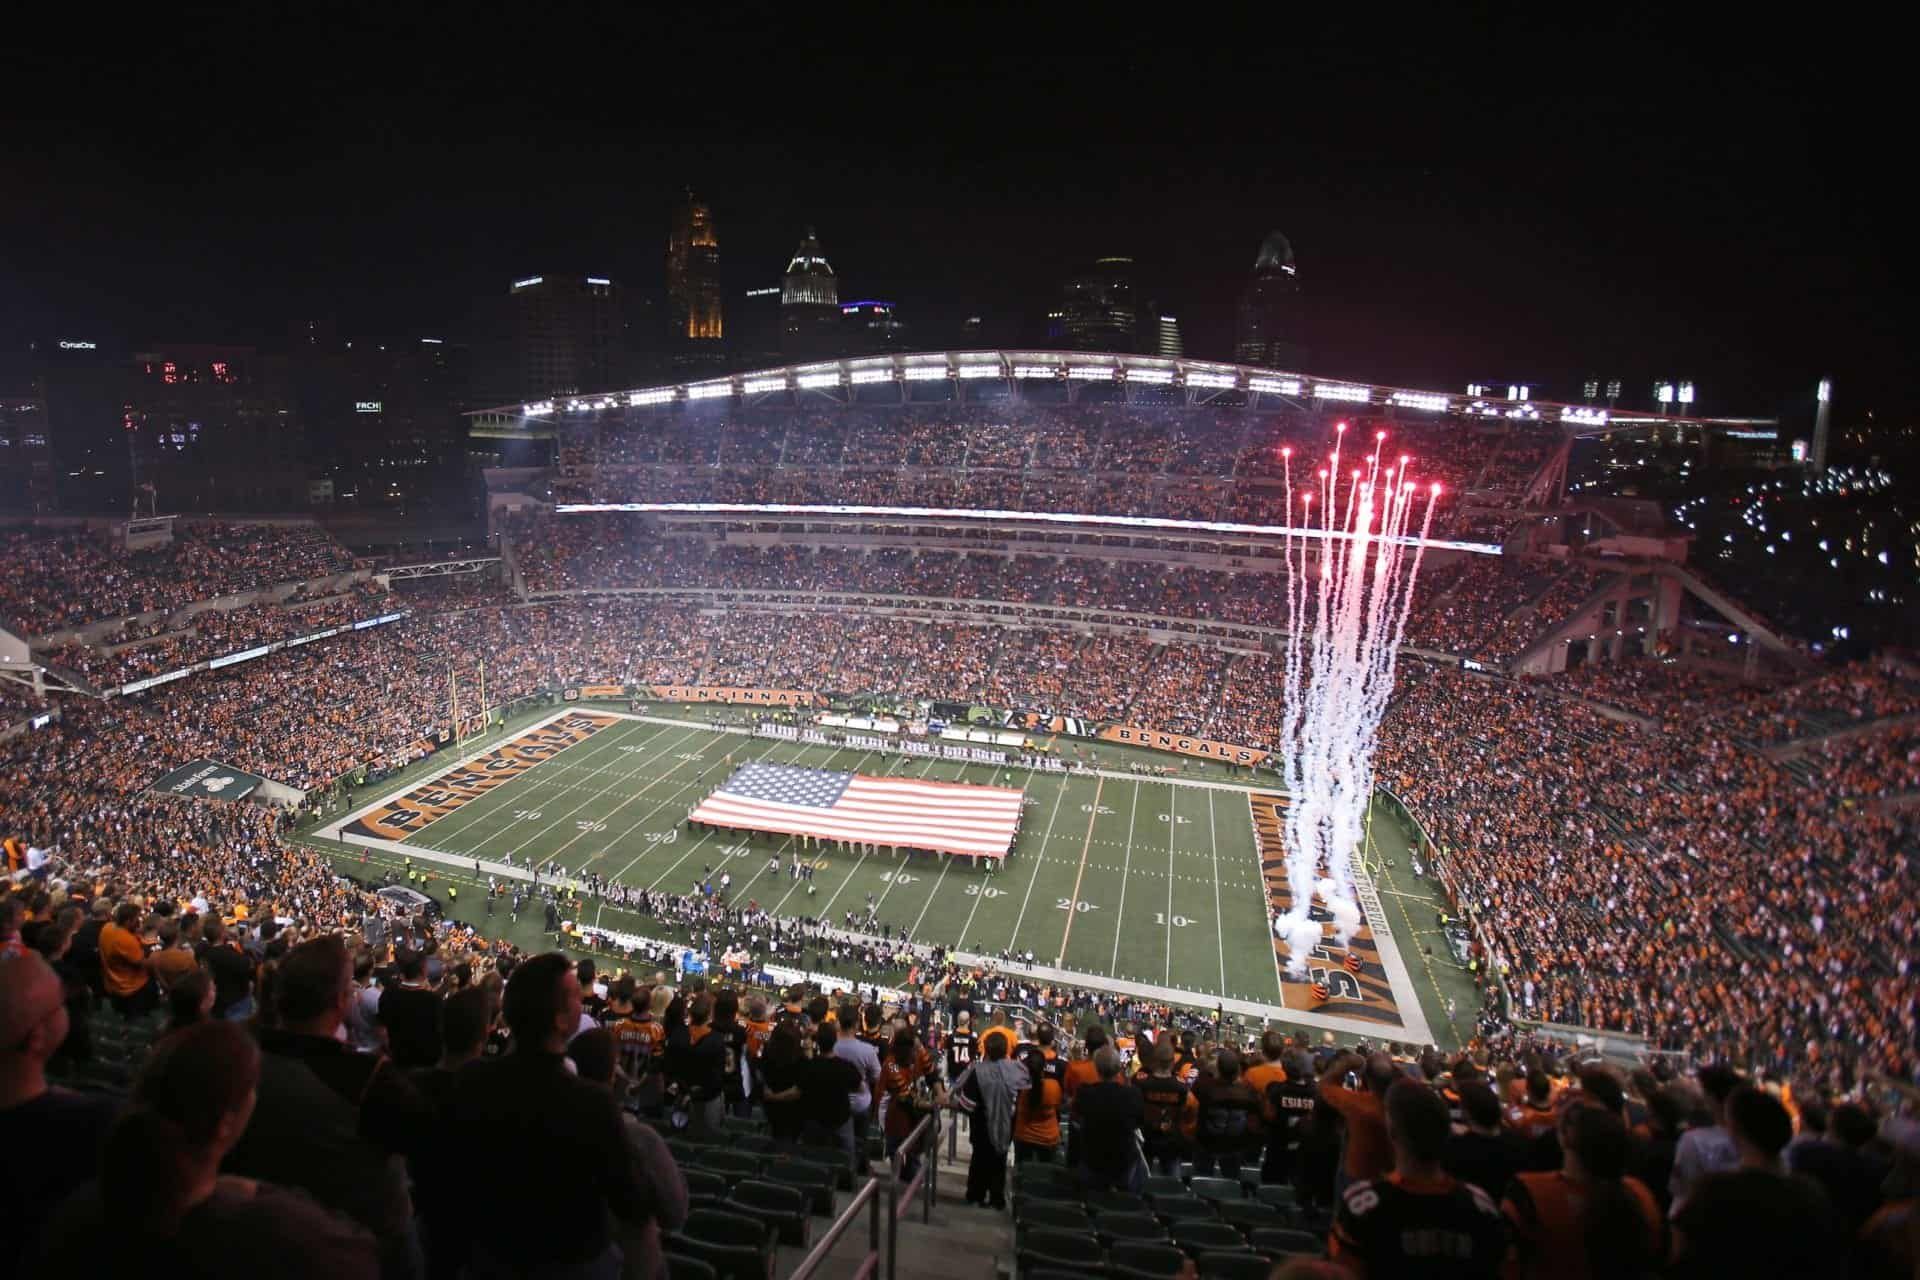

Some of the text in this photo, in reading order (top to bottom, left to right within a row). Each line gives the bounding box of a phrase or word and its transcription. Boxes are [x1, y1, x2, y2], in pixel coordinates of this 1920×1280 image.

[668, 689, 817, 703] CINCINNAT
[1119, 729, 1250, 761] BENGALS
[376, 717, 594, 829] BENGALS
[964, 884, 999, 898] 30
[1055, 898, 1091, 913] 20
[1153, 912, 1188, 927] 10
[1361, 894, 1390, 937] SERVICE
[951, 1046, 970, 1063] 14
[1342, 1179, 1380, 1216] 18
